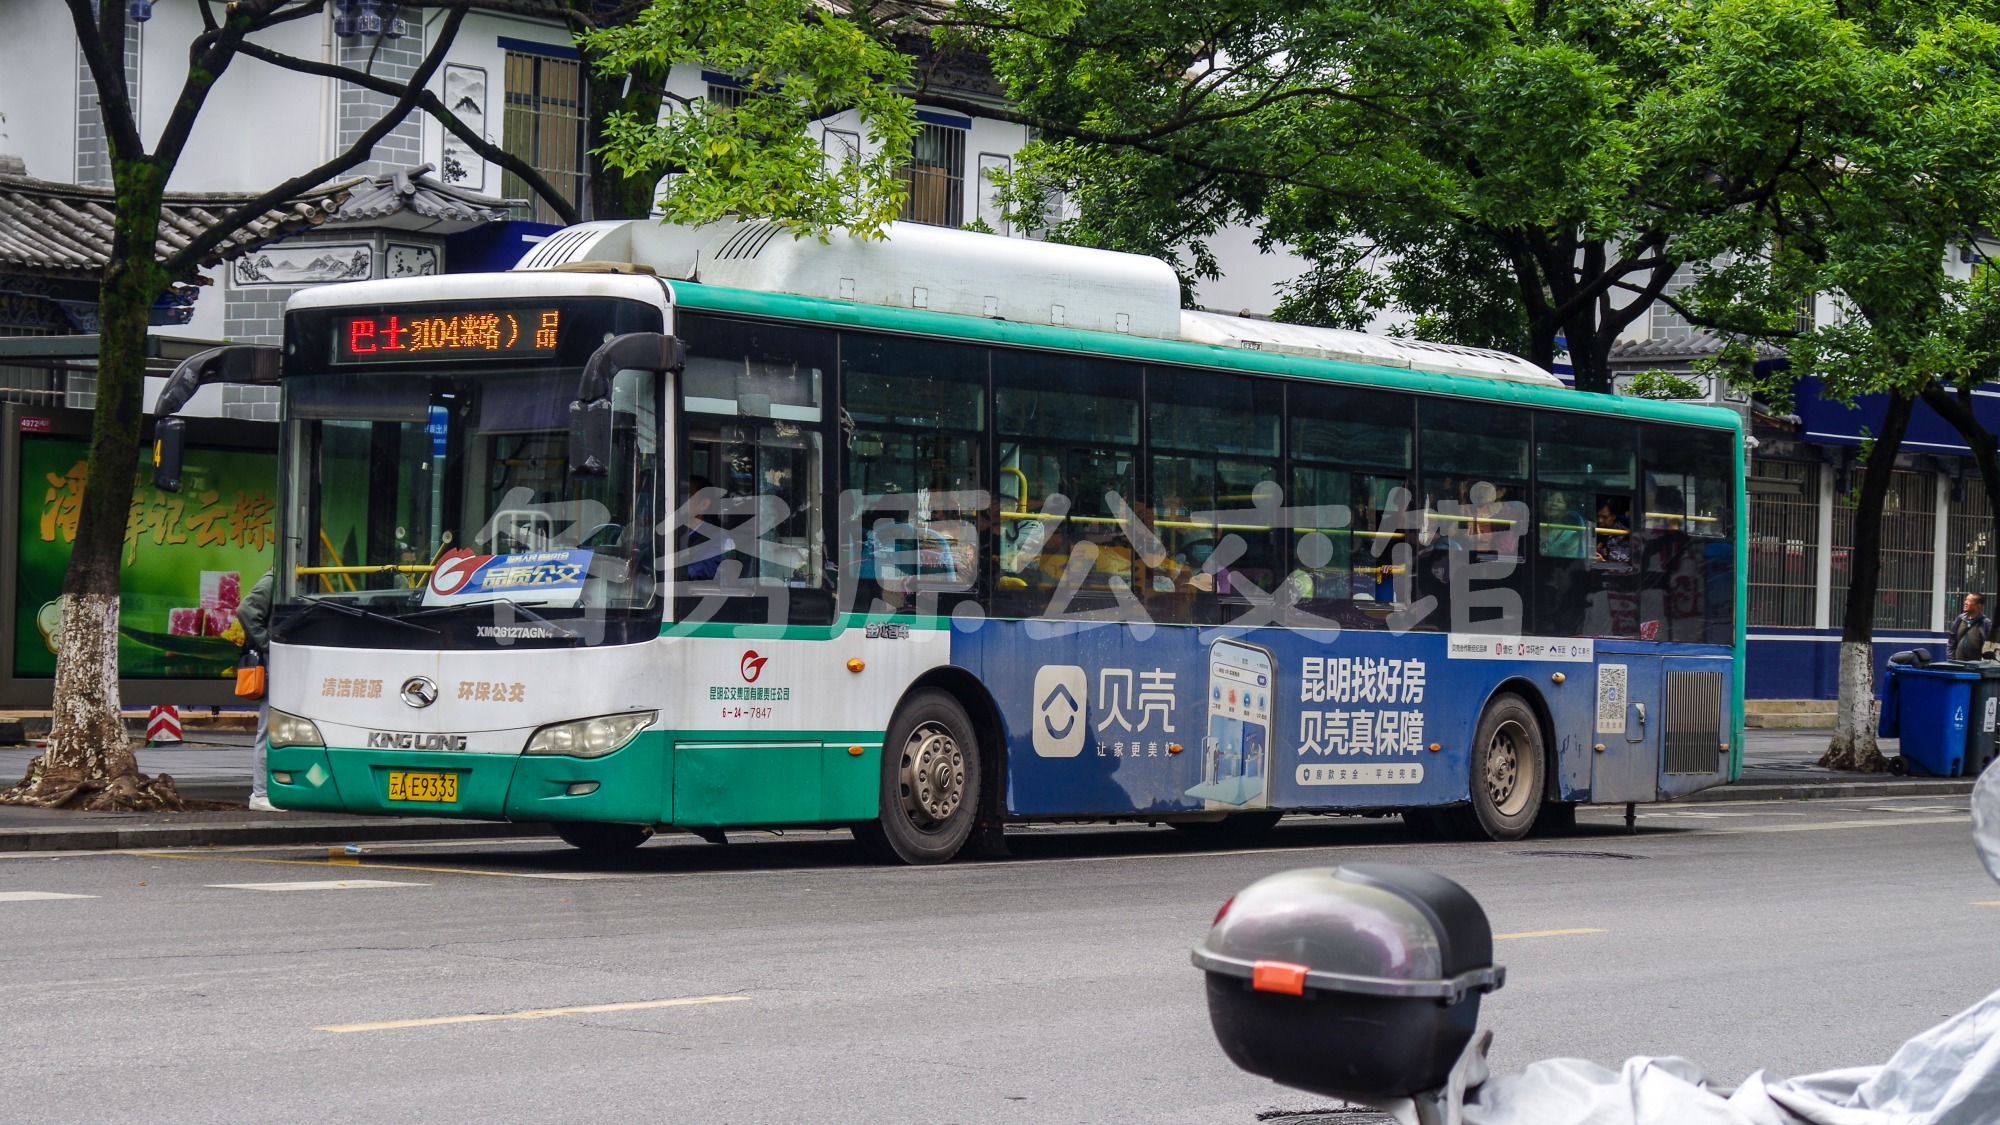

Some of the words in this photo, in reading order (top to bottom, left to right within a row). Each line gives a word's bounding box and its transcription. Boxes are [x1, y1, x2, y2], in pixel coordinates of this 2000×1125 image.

[482, 563, 583, 589] 品质公交
[322, 678, 383, 698] 清洁能源
[458, 681, 525, 702] 环保公交
[710, 686, 790, 700] 昆明公交集团有限责任公司
[1301, 657, 1425, 704] 昆明找好房
[1098, 668, 1176, 732] 贝壳
[367, 732, 412, 748] KING
[415, 735, 467, 750] LONG
[1298, 709, 1424, 756] 贝壳真保障
